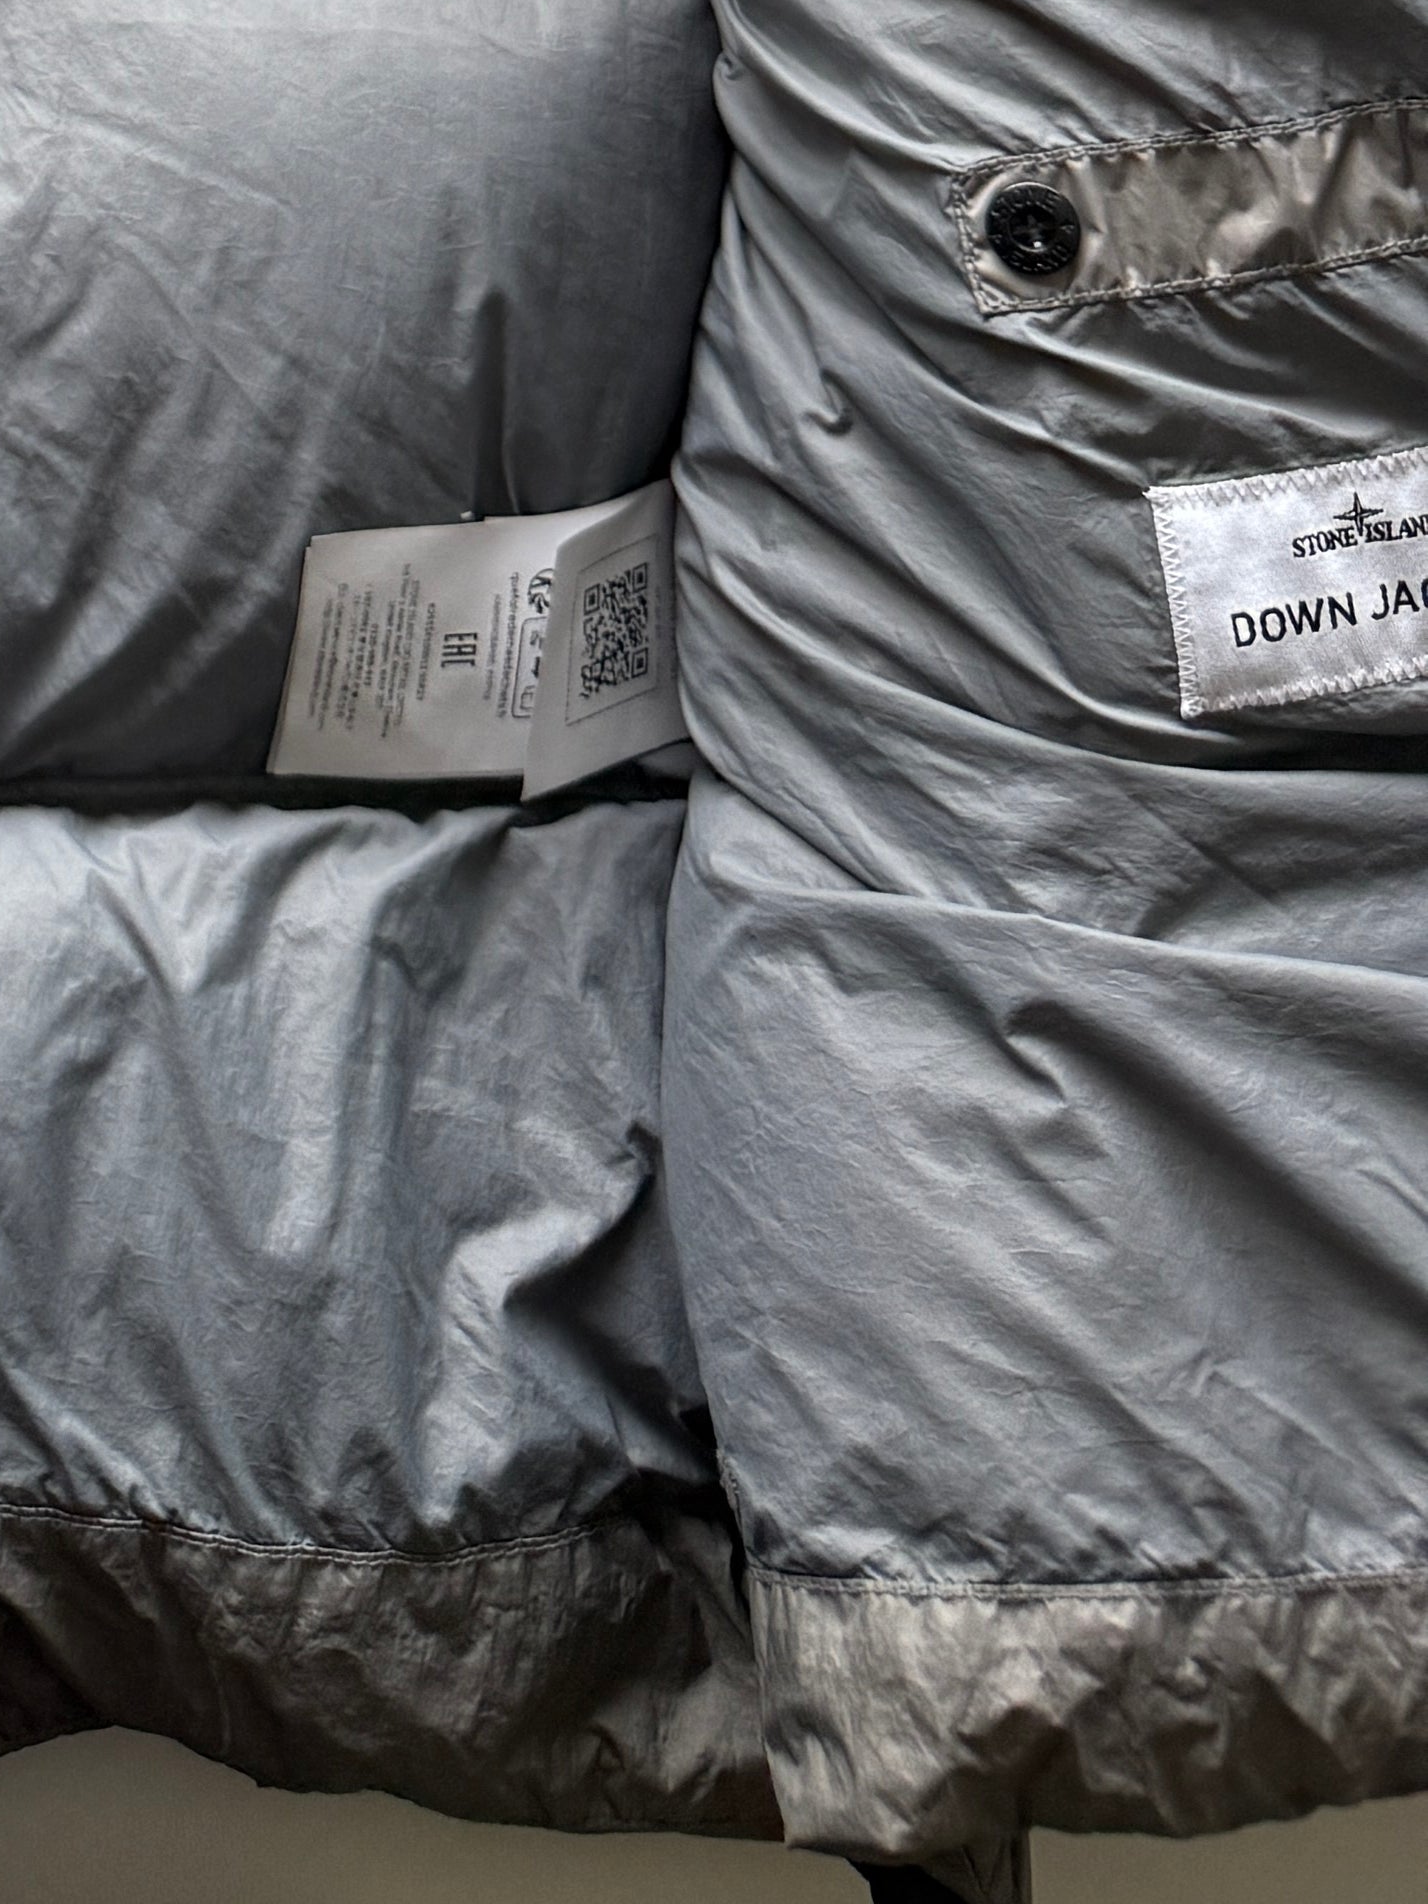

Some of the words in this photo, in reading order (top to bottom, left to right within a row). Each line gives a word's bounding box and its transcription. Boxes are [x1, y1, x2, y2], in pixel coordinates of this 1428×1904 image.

[1292, 526, 1358, 558] STONE
[1231, 592, 1357, 647] DOWN
[1371, 578, 1428, 620] JA
